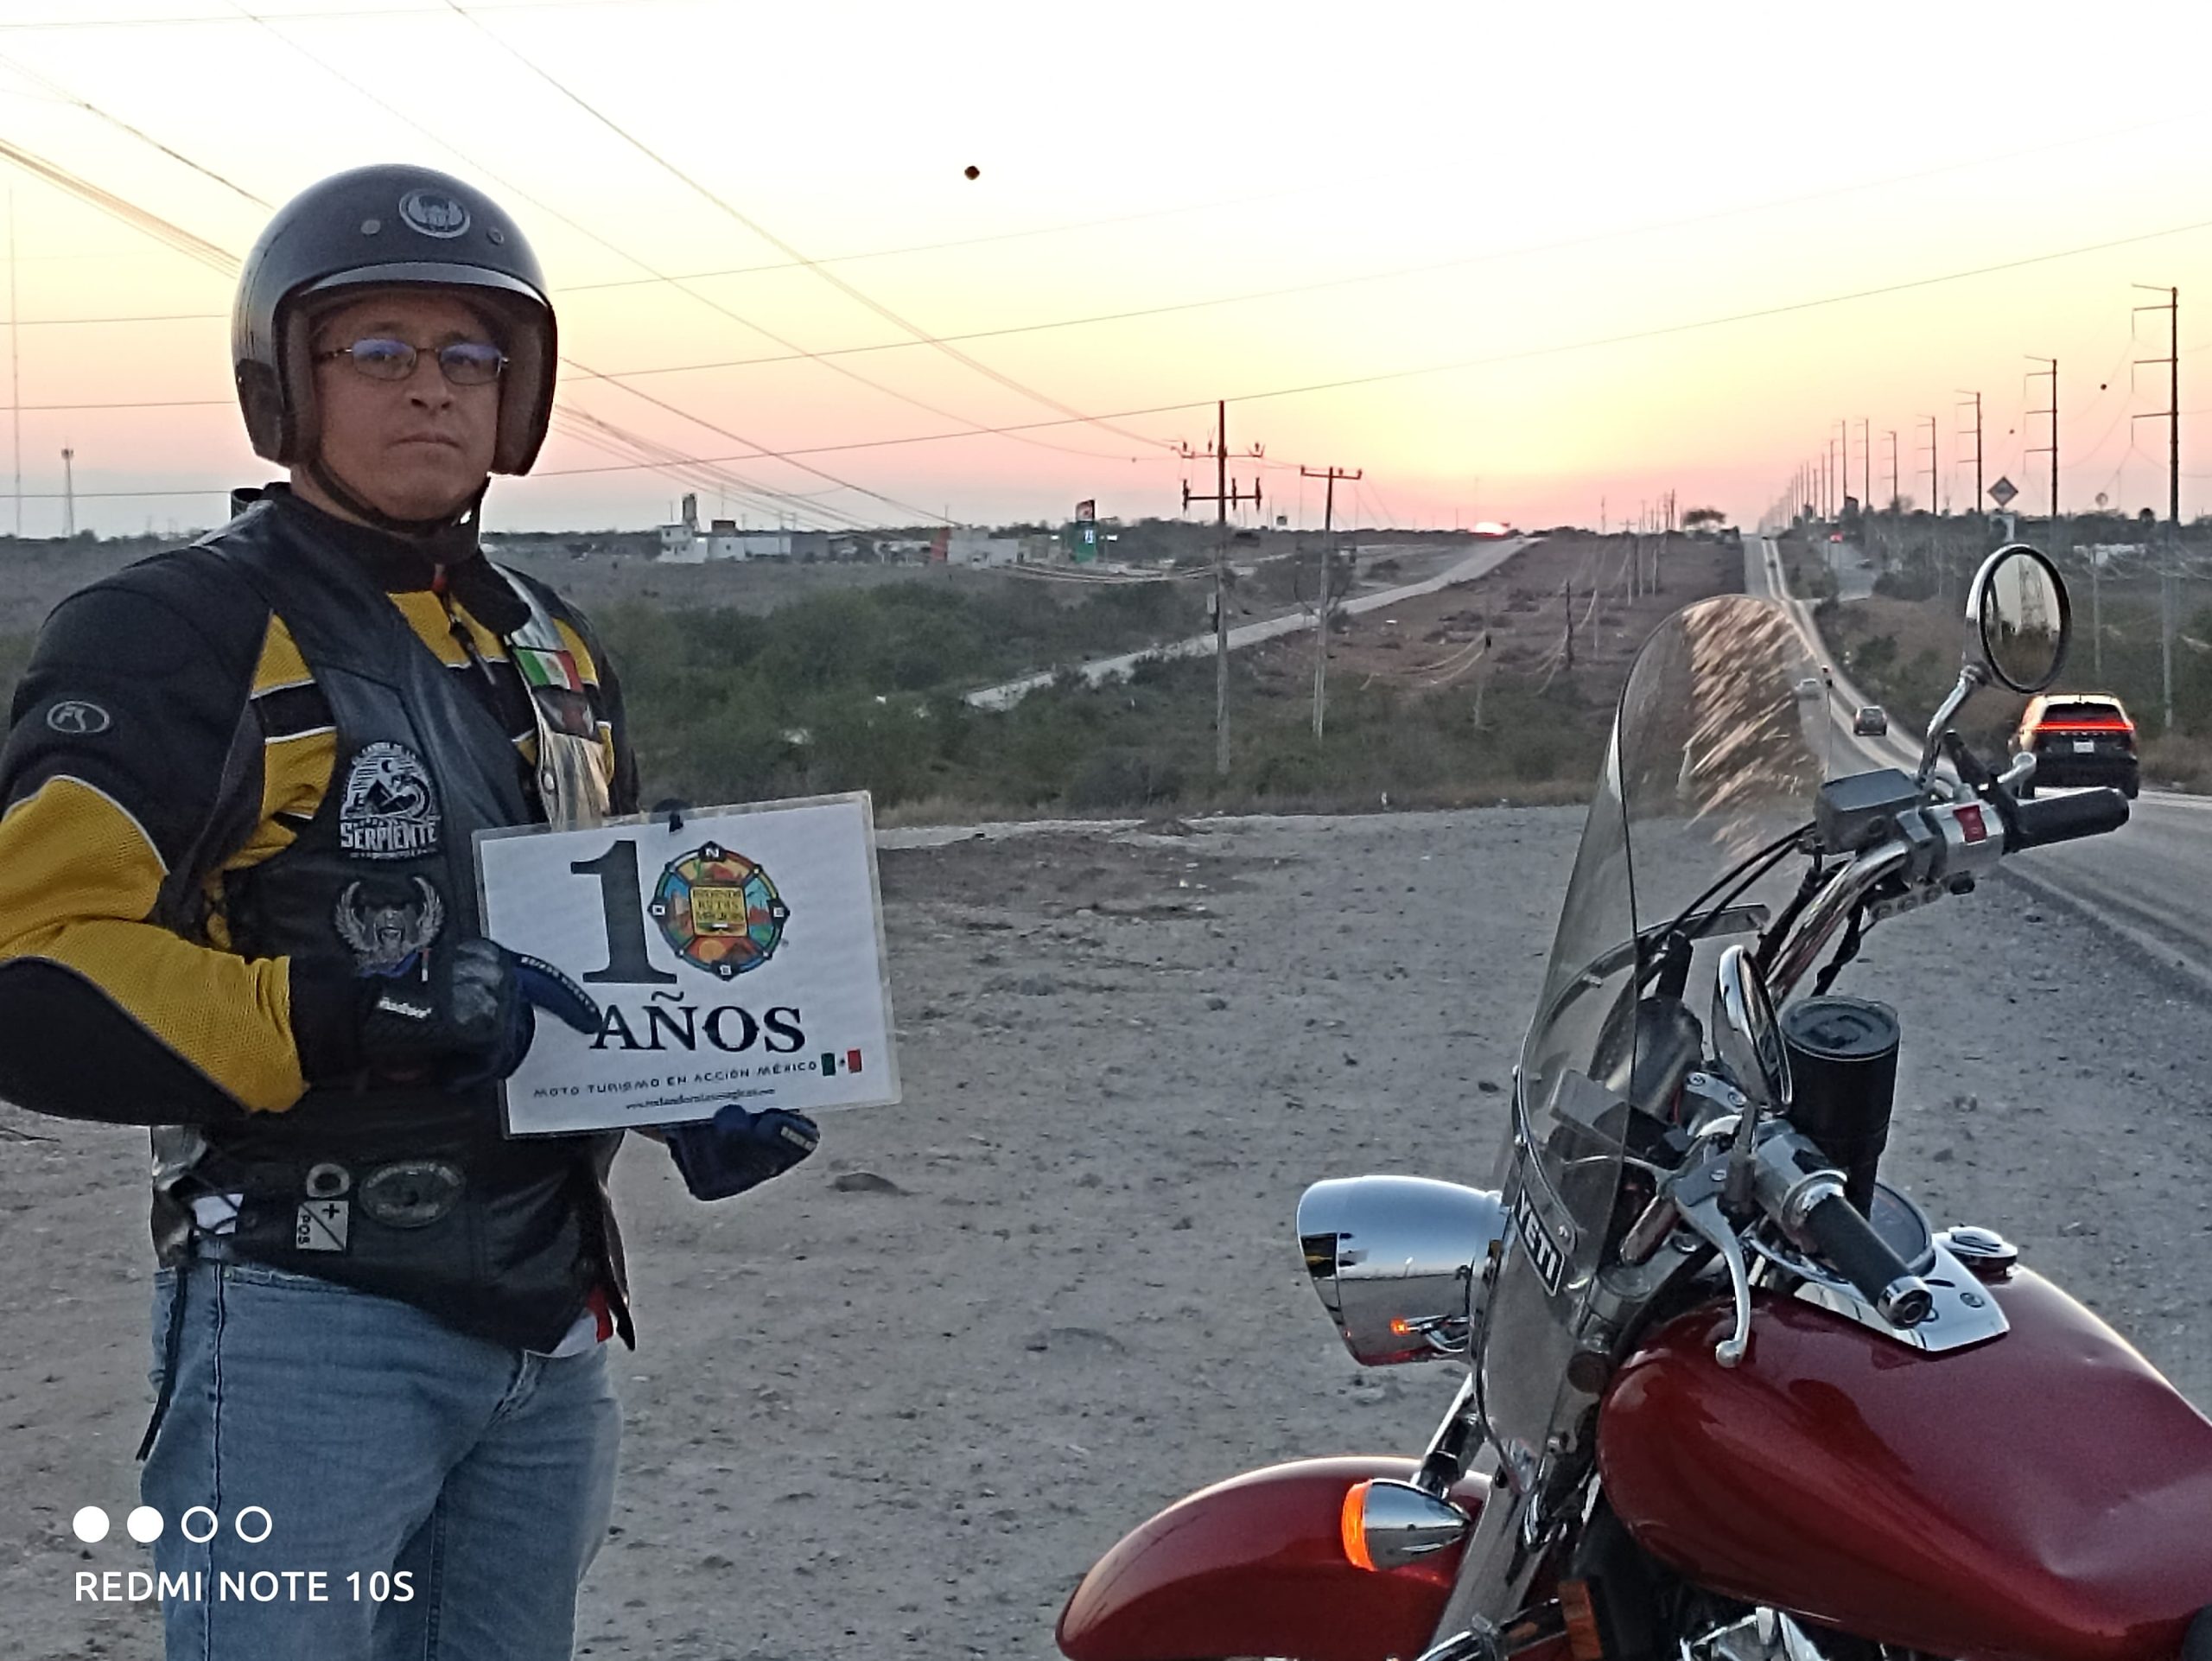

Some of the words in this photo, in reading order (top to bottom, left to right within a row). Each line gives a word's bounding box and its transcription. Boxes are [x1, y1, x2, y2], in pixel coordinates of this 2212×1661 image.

[340, 820, 438, 851] SERPIENTE
[589, 990, 806, 1053] AÑOS
[533, 1085, 580, 1098] MOTO
[588, 1078, 660, 1094] TURISMO
[666, 1076, 687, 1087] EN
[1517, 1187, 1558, 1281] YETI
